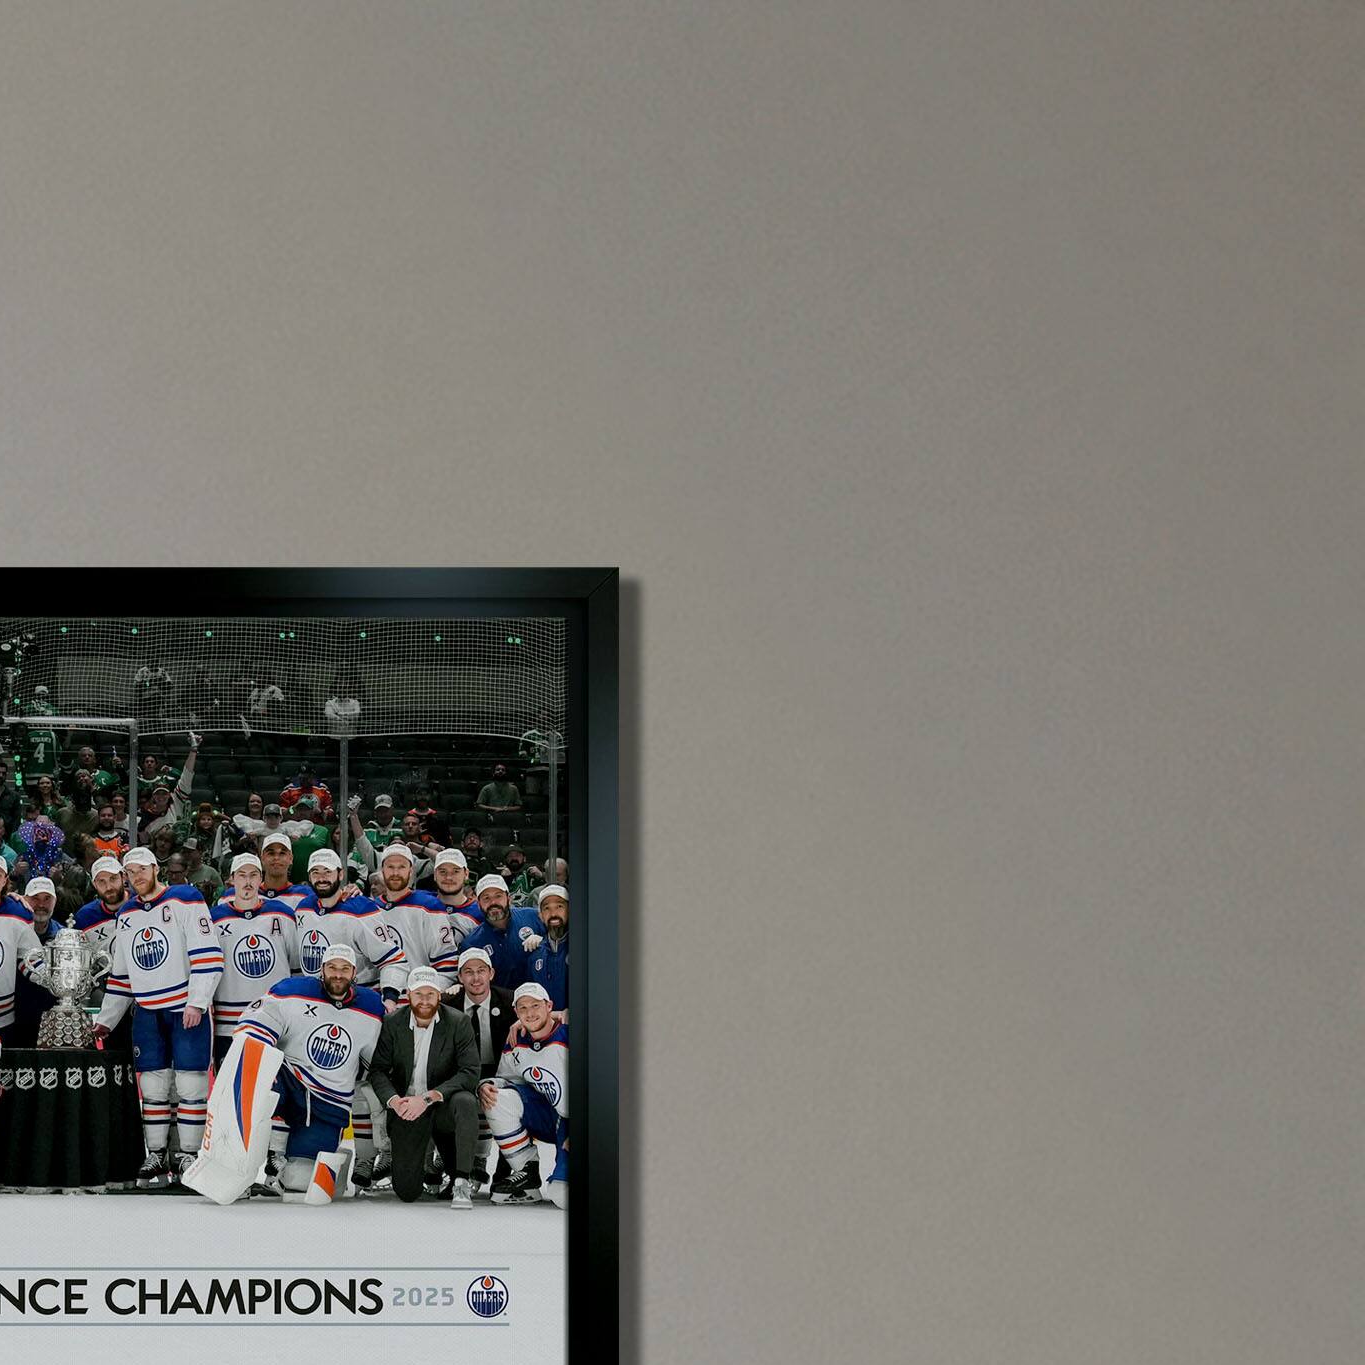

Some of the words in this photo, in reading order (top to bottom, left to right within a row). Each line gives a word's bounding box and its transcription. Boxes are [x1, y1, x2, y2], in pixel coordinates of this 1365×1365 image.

[162, 906, 171, 923] C
[271, 919, 282, 935] A
[135, 940, 164, 968] OILERS
[238, 950, 271, 975] OILERS
[311, 1036, 347, 1066] OILERS
[204, 1112, 214, 1151] CCM
[105, 1279, 384, 1315] CHAMPIONS
[392, 1287, 455, 1307] 2025
[472, 1291, 504, 1315] OILERS
